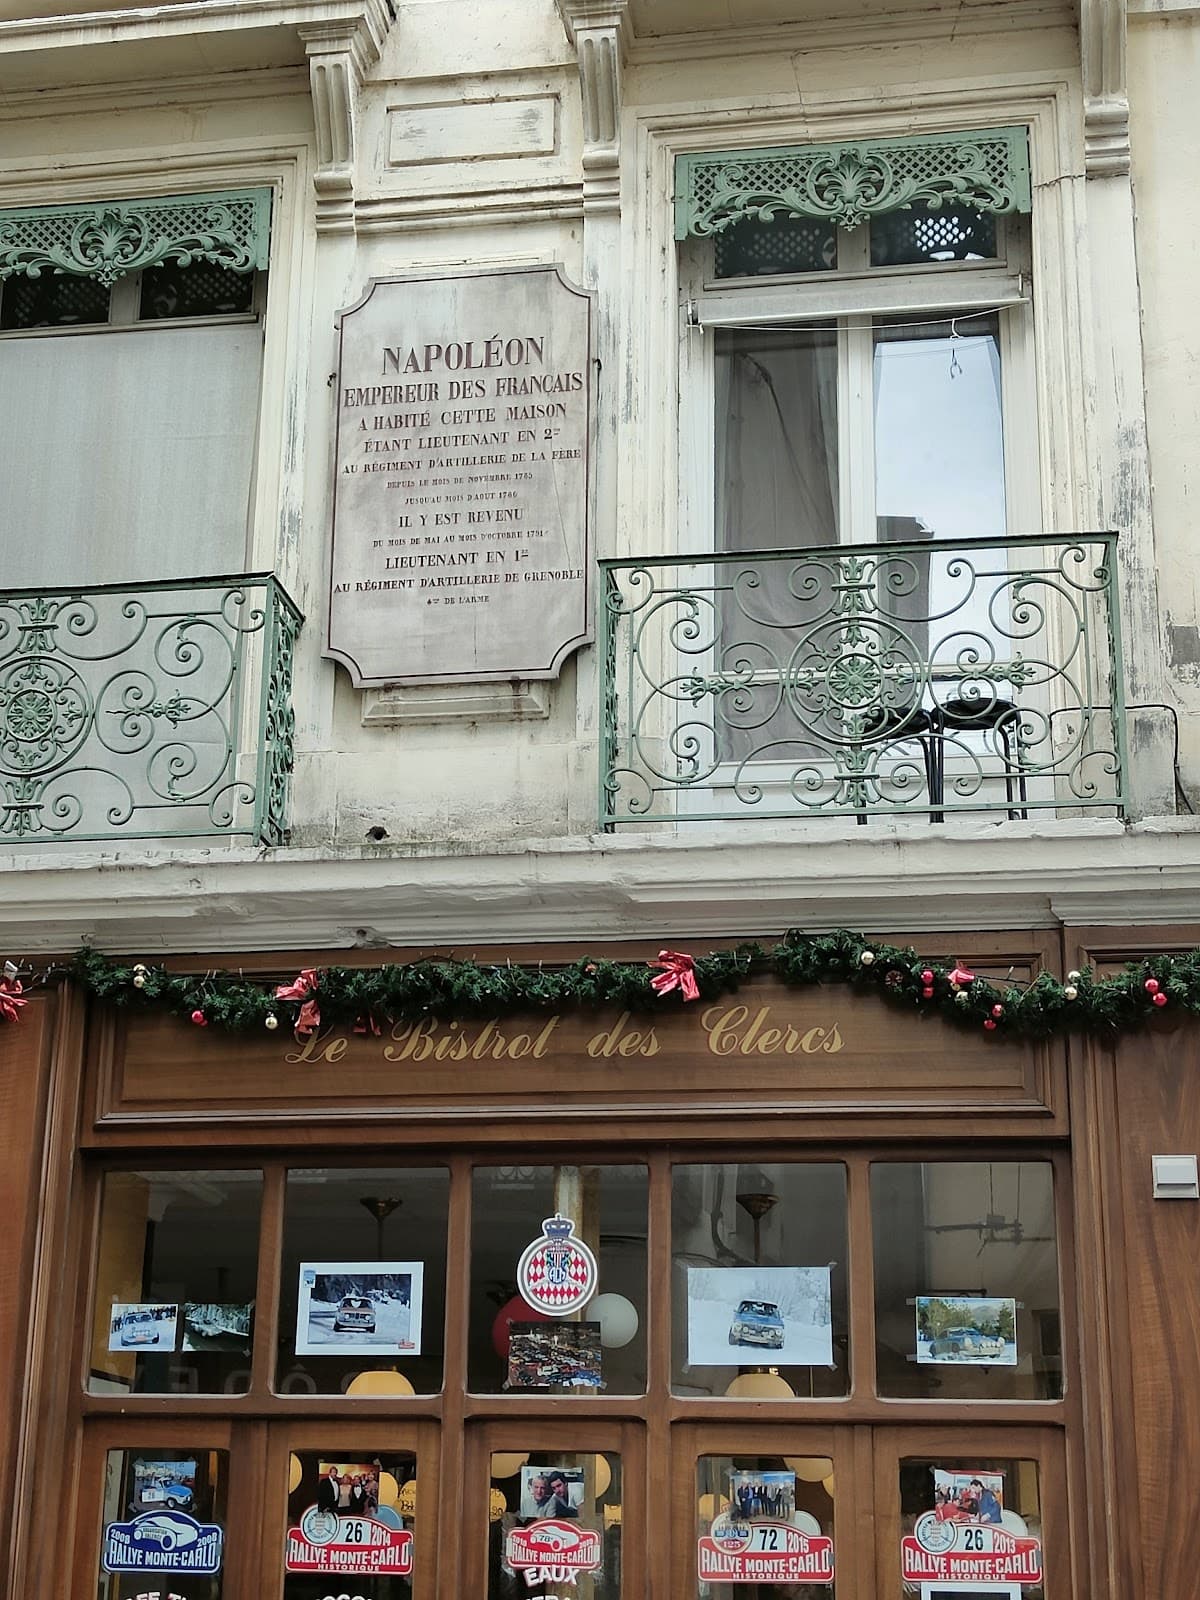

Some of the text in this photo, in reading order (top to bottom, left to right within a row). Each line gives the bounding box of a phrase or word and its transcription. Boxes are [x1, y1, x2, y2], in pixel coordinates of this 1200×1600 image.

[382, 334, 544, 375] NAPOLÉON
[344, 372, 583, 407] EMPEREUR DES FRANÇAIS
[358, 403, 567, 431] A HABITÉ CETTE MAISON
[364, 437, 413, 453] ÉTANT
[418, 431, 510, 449] LIEUTENANT
[517, 430, 536, 442] EN
[342, 447, 581, 474] AU RÉGIMENT D'ARTILLERIE DE LA FÈRE
[387, 479, 415, 489] DEPUIS
[419, 478, 429, 487] LE
[431, 477, 450, 486] MOIS
[454, 476, 464, 485] DE
[468, 473, 512, 484] NOVEMBRE
[445, 494, 464, 503] MOIS
[399, 508, 524, 528] IL Y EST REVENU
[373, 539, 384, 549] DU
[388, 538, 407, 547] MOIS
[410, 537, 421, 545] DE
[424, 536, 440, 545] MAI
[444, 535, 455, 543] AU
[458, 534, 477, 542] MOIS
[385, 552, 479, 570] LIEUTENANT
[486, 550, 506, 563] EN
[334, 570, 584, 593] AU RÉGIMENT D'ARTILLERIE DE GRENOBLE
[444, 597, 456, 605] DE
[458, 595, 490, 604] L'ARME
[285, 1005, 846, 1064] Le Bistrot des Clercs
[345, 1522, 362, 1543] 26
[371, 1525, 391, 1546] 2014
[759, 1529, 778, 1550] 72
[787, 1532, 810, 1553] 2015
[965, 1529, 984, 1551] 26
[993, 1531, 1016, 1554] 2013
[109, 1540, 216, 1567] RALLYE MONTE-CARLO
[289, 1538, 409, 1566] RALLYE MONTE-CARLO
[511, 1544, 597, 1563] RALLYE MONTE-CARLO
[701, 1547, 831, 1573] RALLYE MONTE-CARLO
[905, 1547, 1038, 1574] RALLYE MONTE-CARLO
[523, 1566, 580, 1588] EAUX
[937, 1573, 1006, 1581] HISTORIQUE
